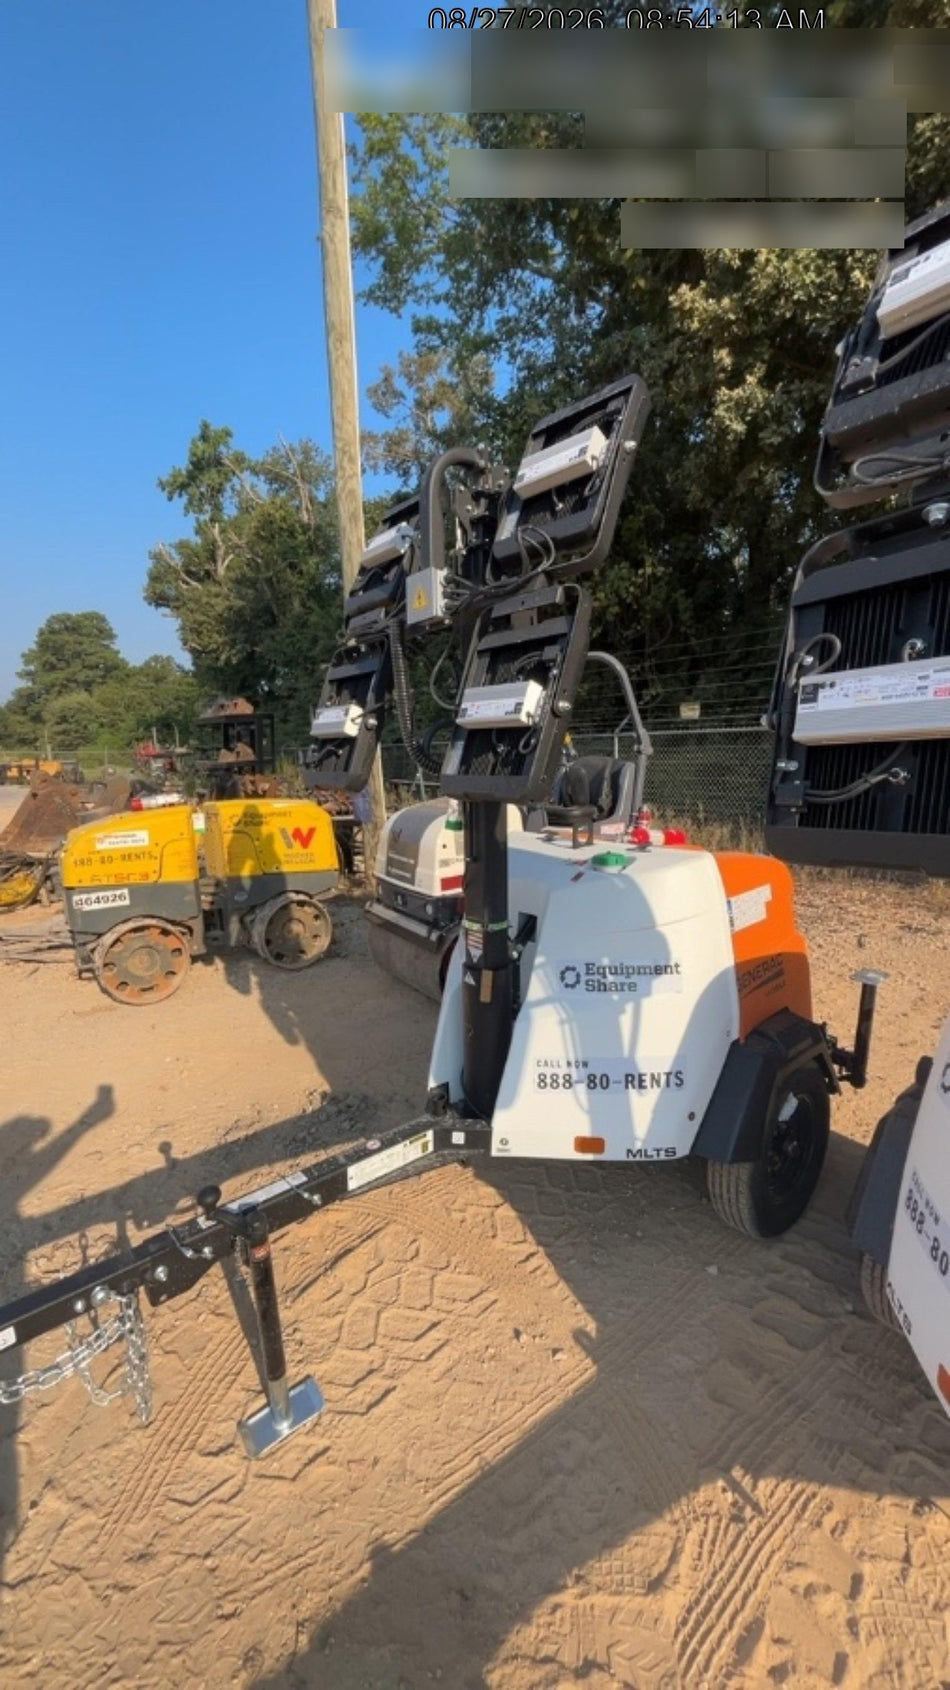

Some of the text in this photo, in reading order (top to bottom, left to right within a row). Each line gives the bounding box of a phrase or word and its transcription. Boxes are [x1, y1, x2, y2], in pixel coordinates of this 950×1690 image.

[584, 962, 681, 978] Equipment
[584, 978, 637, 992] Share
[536, 1060, 589, 1069] CALL NOW
[537, 1071, 685, 1091] 888-80-RENTS
[626, 1147, 677, 1160] MLTS
